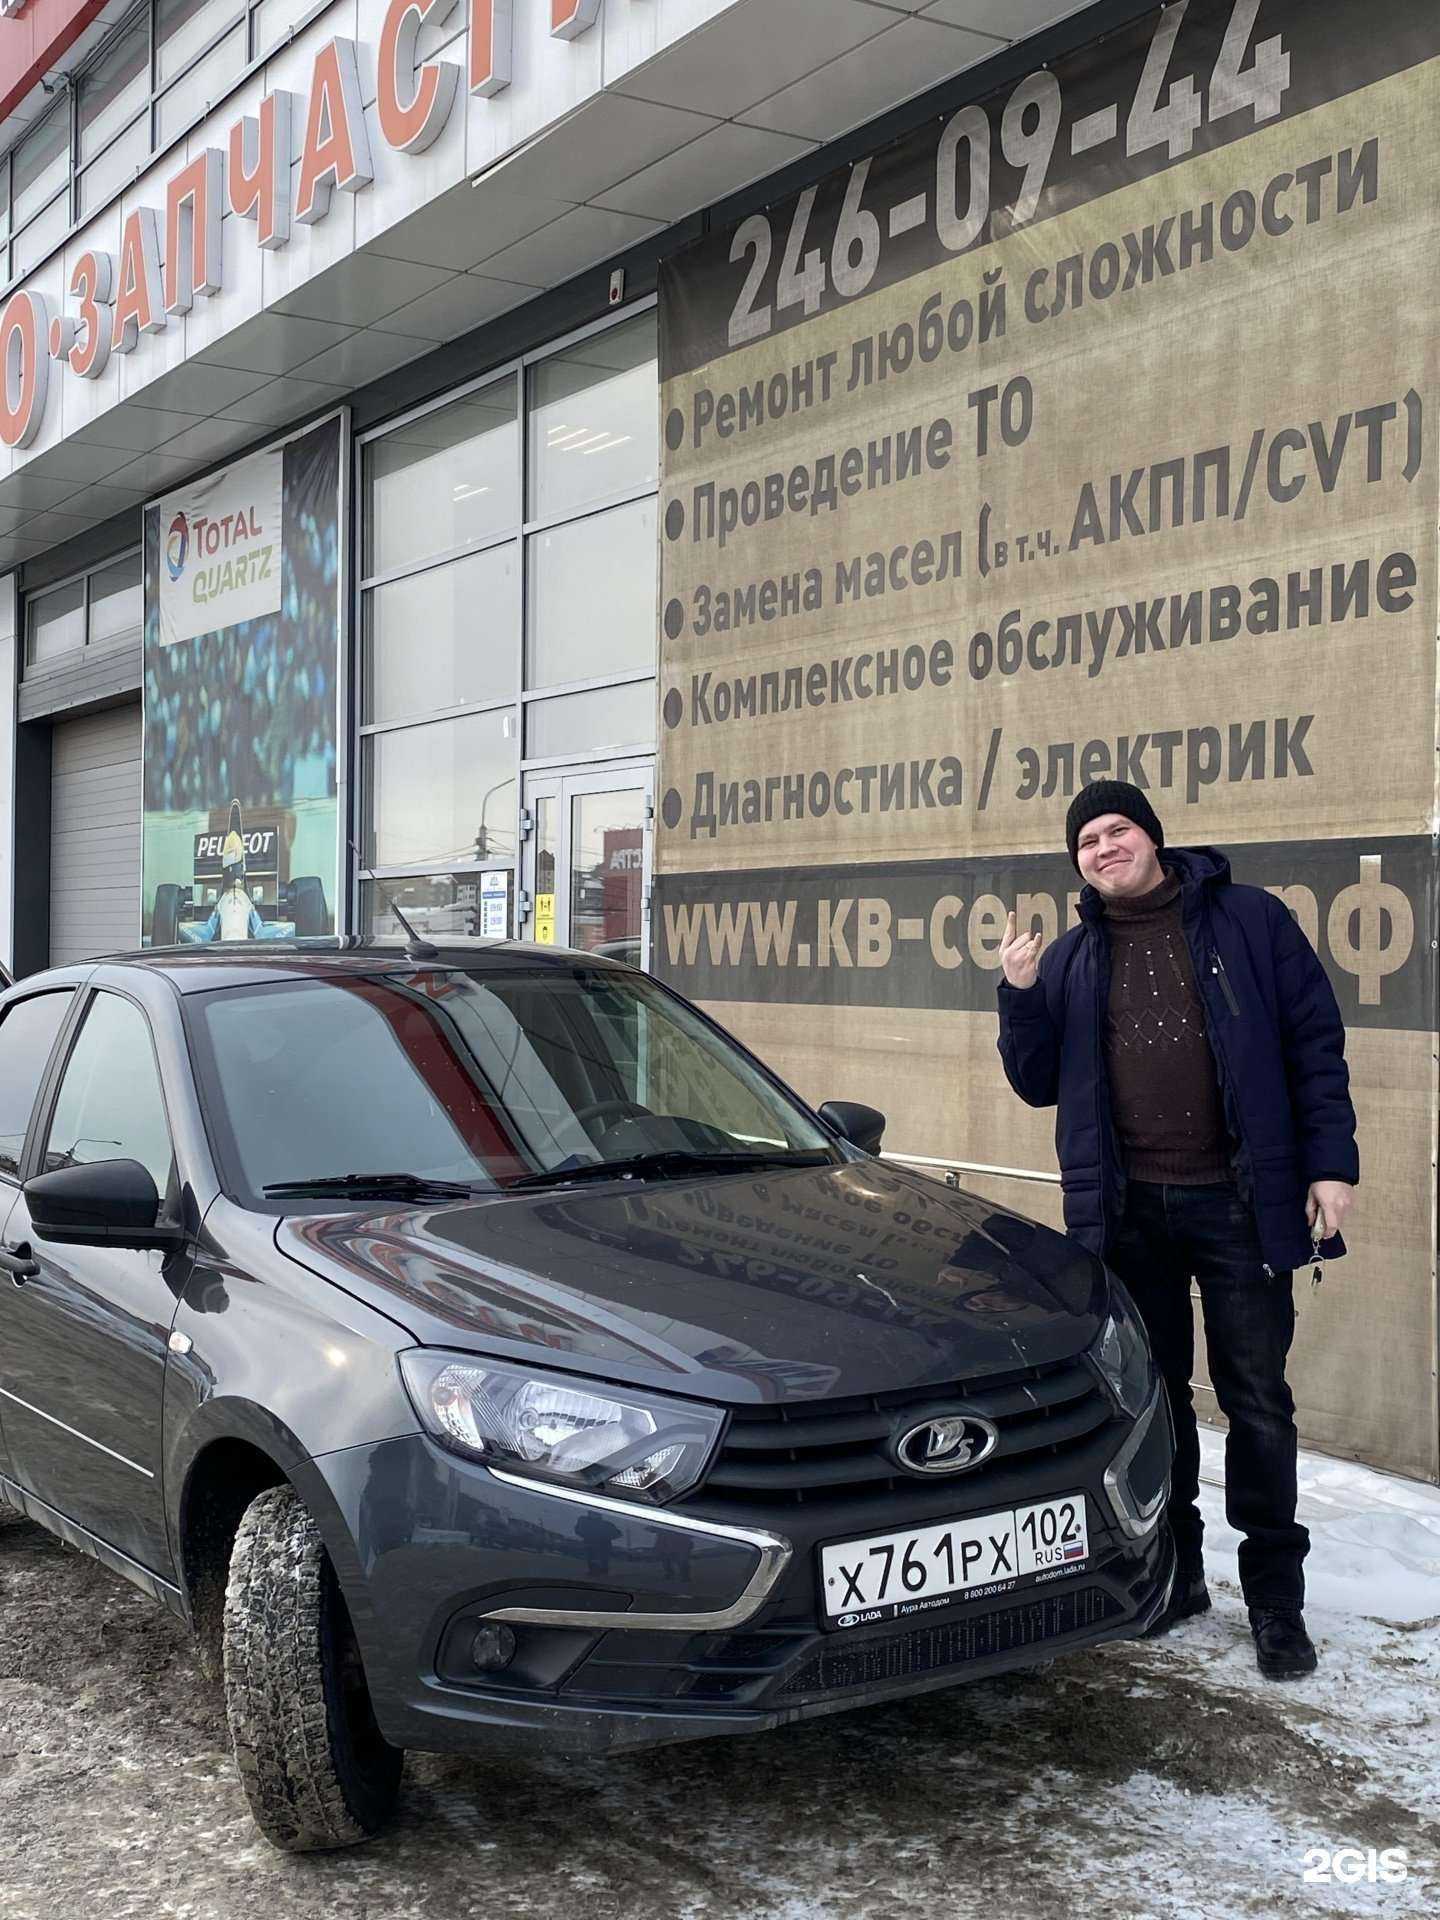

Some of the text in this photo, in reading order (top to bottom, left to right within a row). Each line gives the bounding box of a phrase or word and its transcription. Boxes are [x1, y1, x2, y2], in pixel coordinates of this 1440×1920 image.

[728, 0, 1290, 347] 246-09-44
[694, 138, 1379, 448] Ремонт любой сложности
[693, 376, 1033, 548] Проведение ТО
[193, 506, 262, 558] TOTAL
[193, 545, 272, 604] QUARTZ
[693, 568, 822, 636] Замена
[835, 531, 962, 604] масел
[692, 552, 1416, 726] Комплексное обслуживание
[690, 756, 963, 840] Диагностика
[1015, 714, 1315, 804] электрик
[197, 832, 274, 857] PEUEOT
[1021, 1503, 1077, 1550] 102
[1035, 1547, 1062, 1565] RUS
[860, 1611, 882, 1622] LADA
